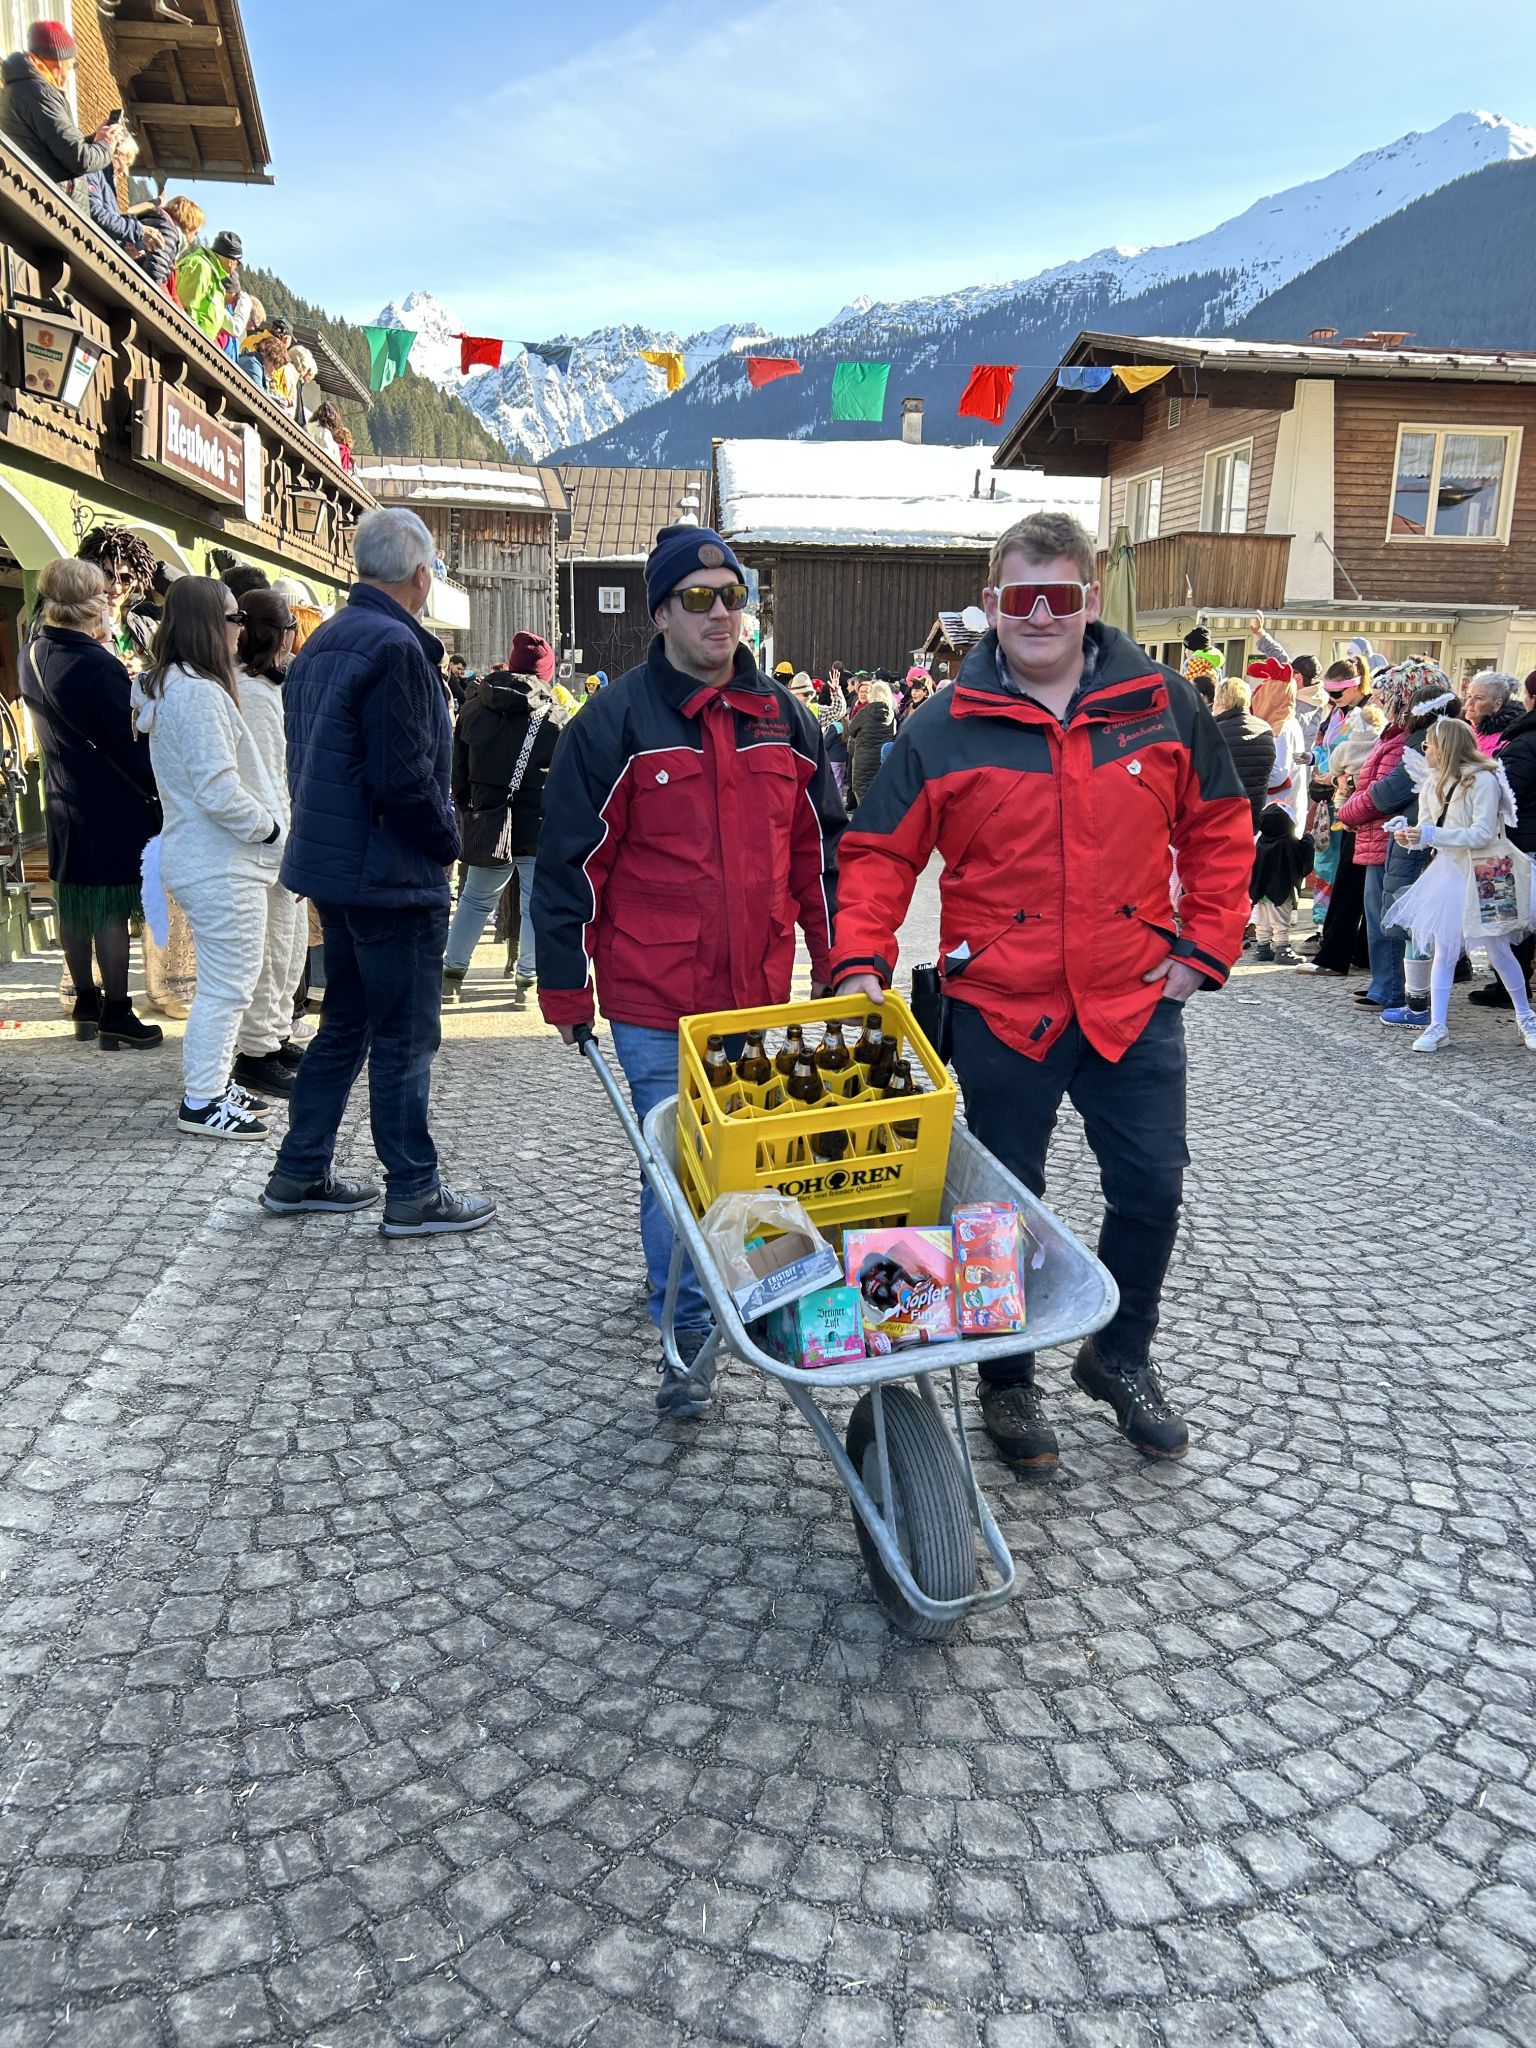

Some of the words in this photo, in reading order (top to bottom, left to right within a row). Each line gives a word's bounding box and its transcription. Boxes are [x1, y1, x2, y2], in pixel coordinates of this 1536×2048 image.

[167, 404, 225, 481] Heuboda
[767, 1266, 797, 1286] ERISTOFF
[770, 1281, 782, 1292] ICE
[911, 1309, 932, 1320] Fun
[824, 1317, 840, 1329] Luft
